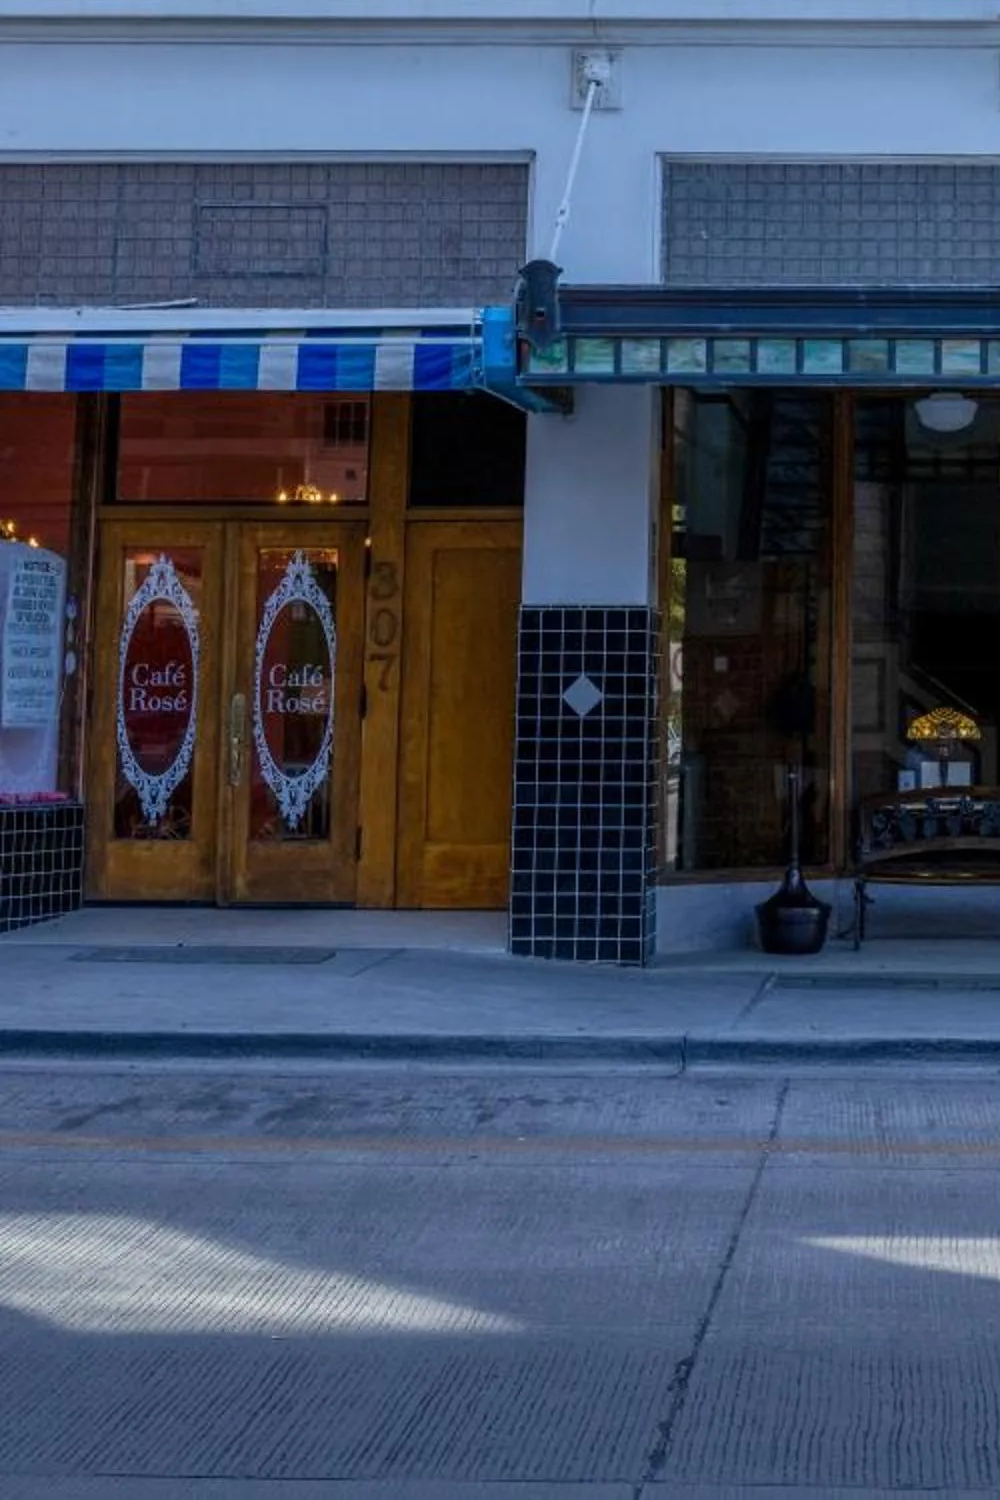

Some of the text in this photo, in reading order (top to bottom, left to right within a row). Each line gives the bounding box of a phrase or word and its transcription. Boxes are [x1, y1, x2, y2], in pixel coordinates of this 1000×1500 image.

[368, 561, 399, 692] 307
[131, 663, 187, 687] Café
[269, 663, 324, 687] Café
[128, 688, 188, 712] Rosé
[266, 689, 327, 713] Rosé
